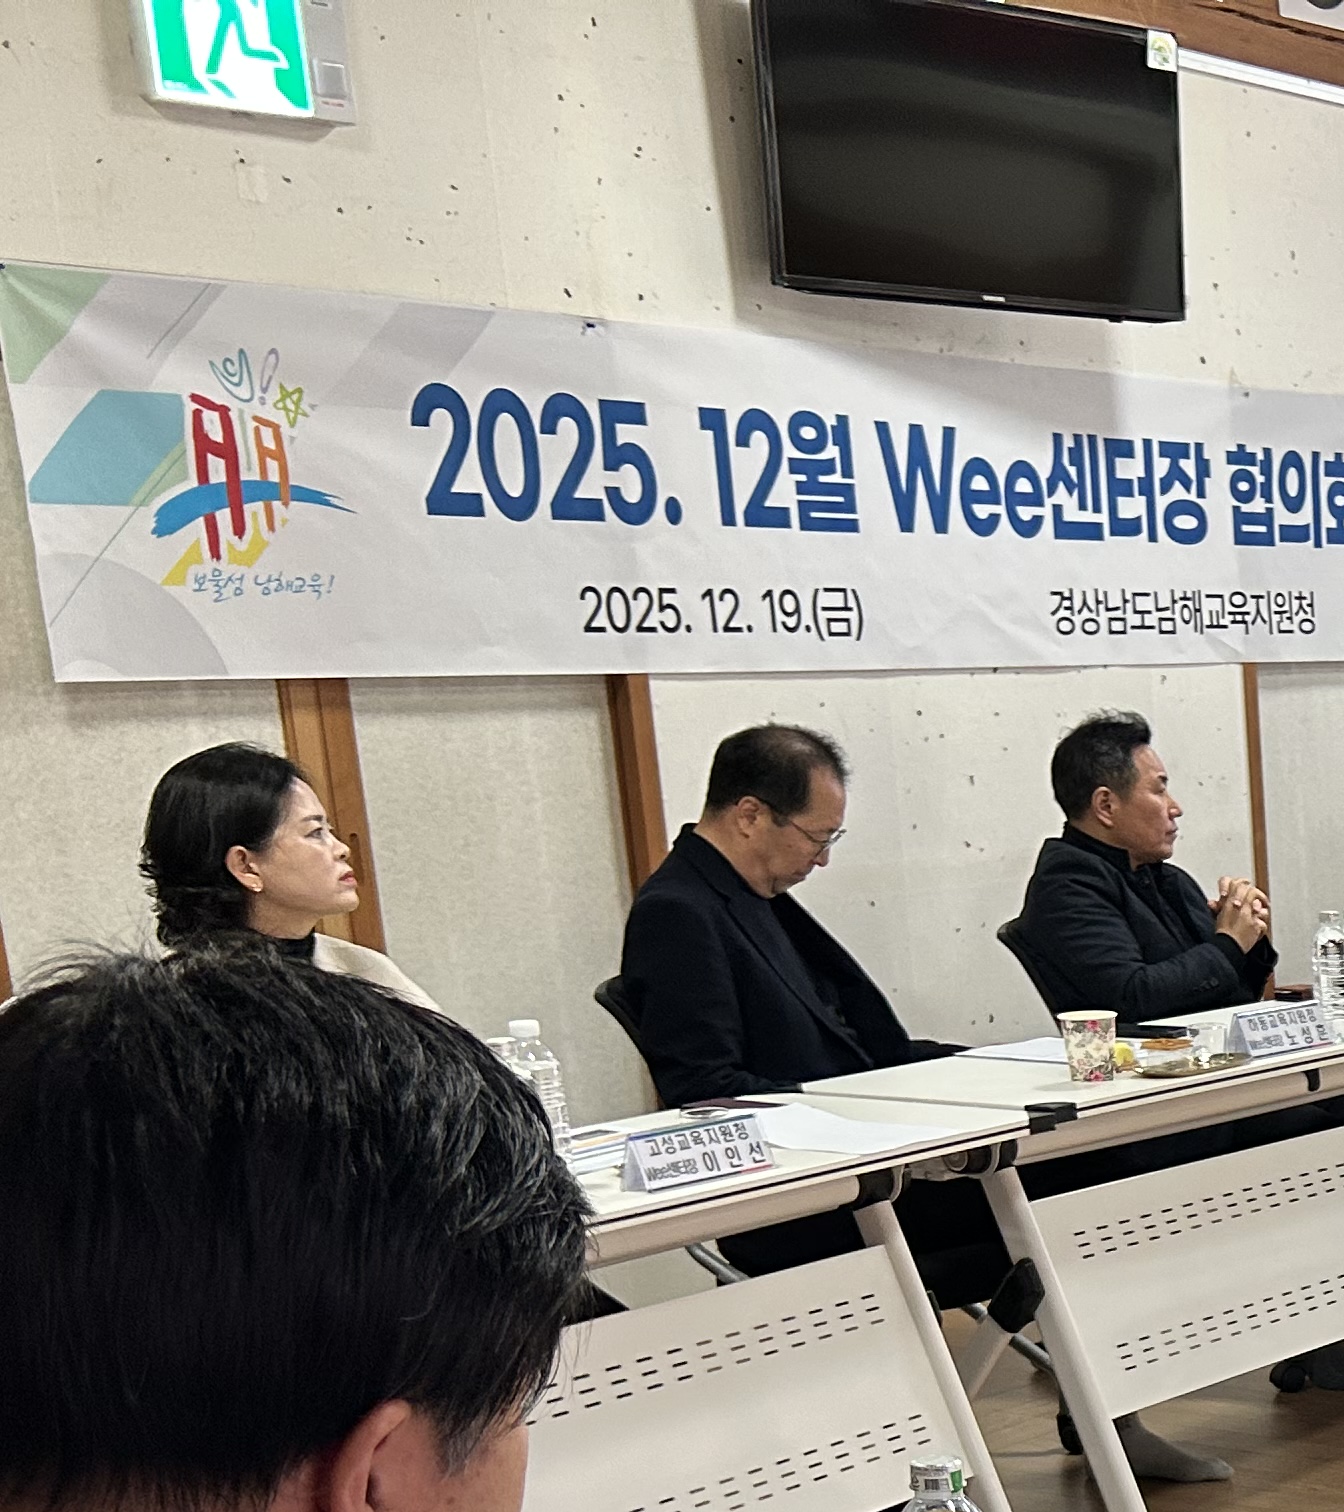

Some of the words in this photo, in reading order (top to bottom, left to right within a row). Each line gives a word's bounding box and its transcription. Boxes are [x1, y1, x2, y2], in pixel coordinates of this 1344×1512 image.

[410, 381, 683, 527] 2025.
[697, 406, 861, 534] 12월
[873, 418, 1212, 546] Wee센터장
[579, 585, 692, 635] 2025.
[700, 587, 754, 635] 12.
[761, 587, 865, 642] 19.(금)
[1049, 588, 1317, 638] 경상남도남해교육지원청
[644, 1121, 750, 1157] 고성교육지원청
